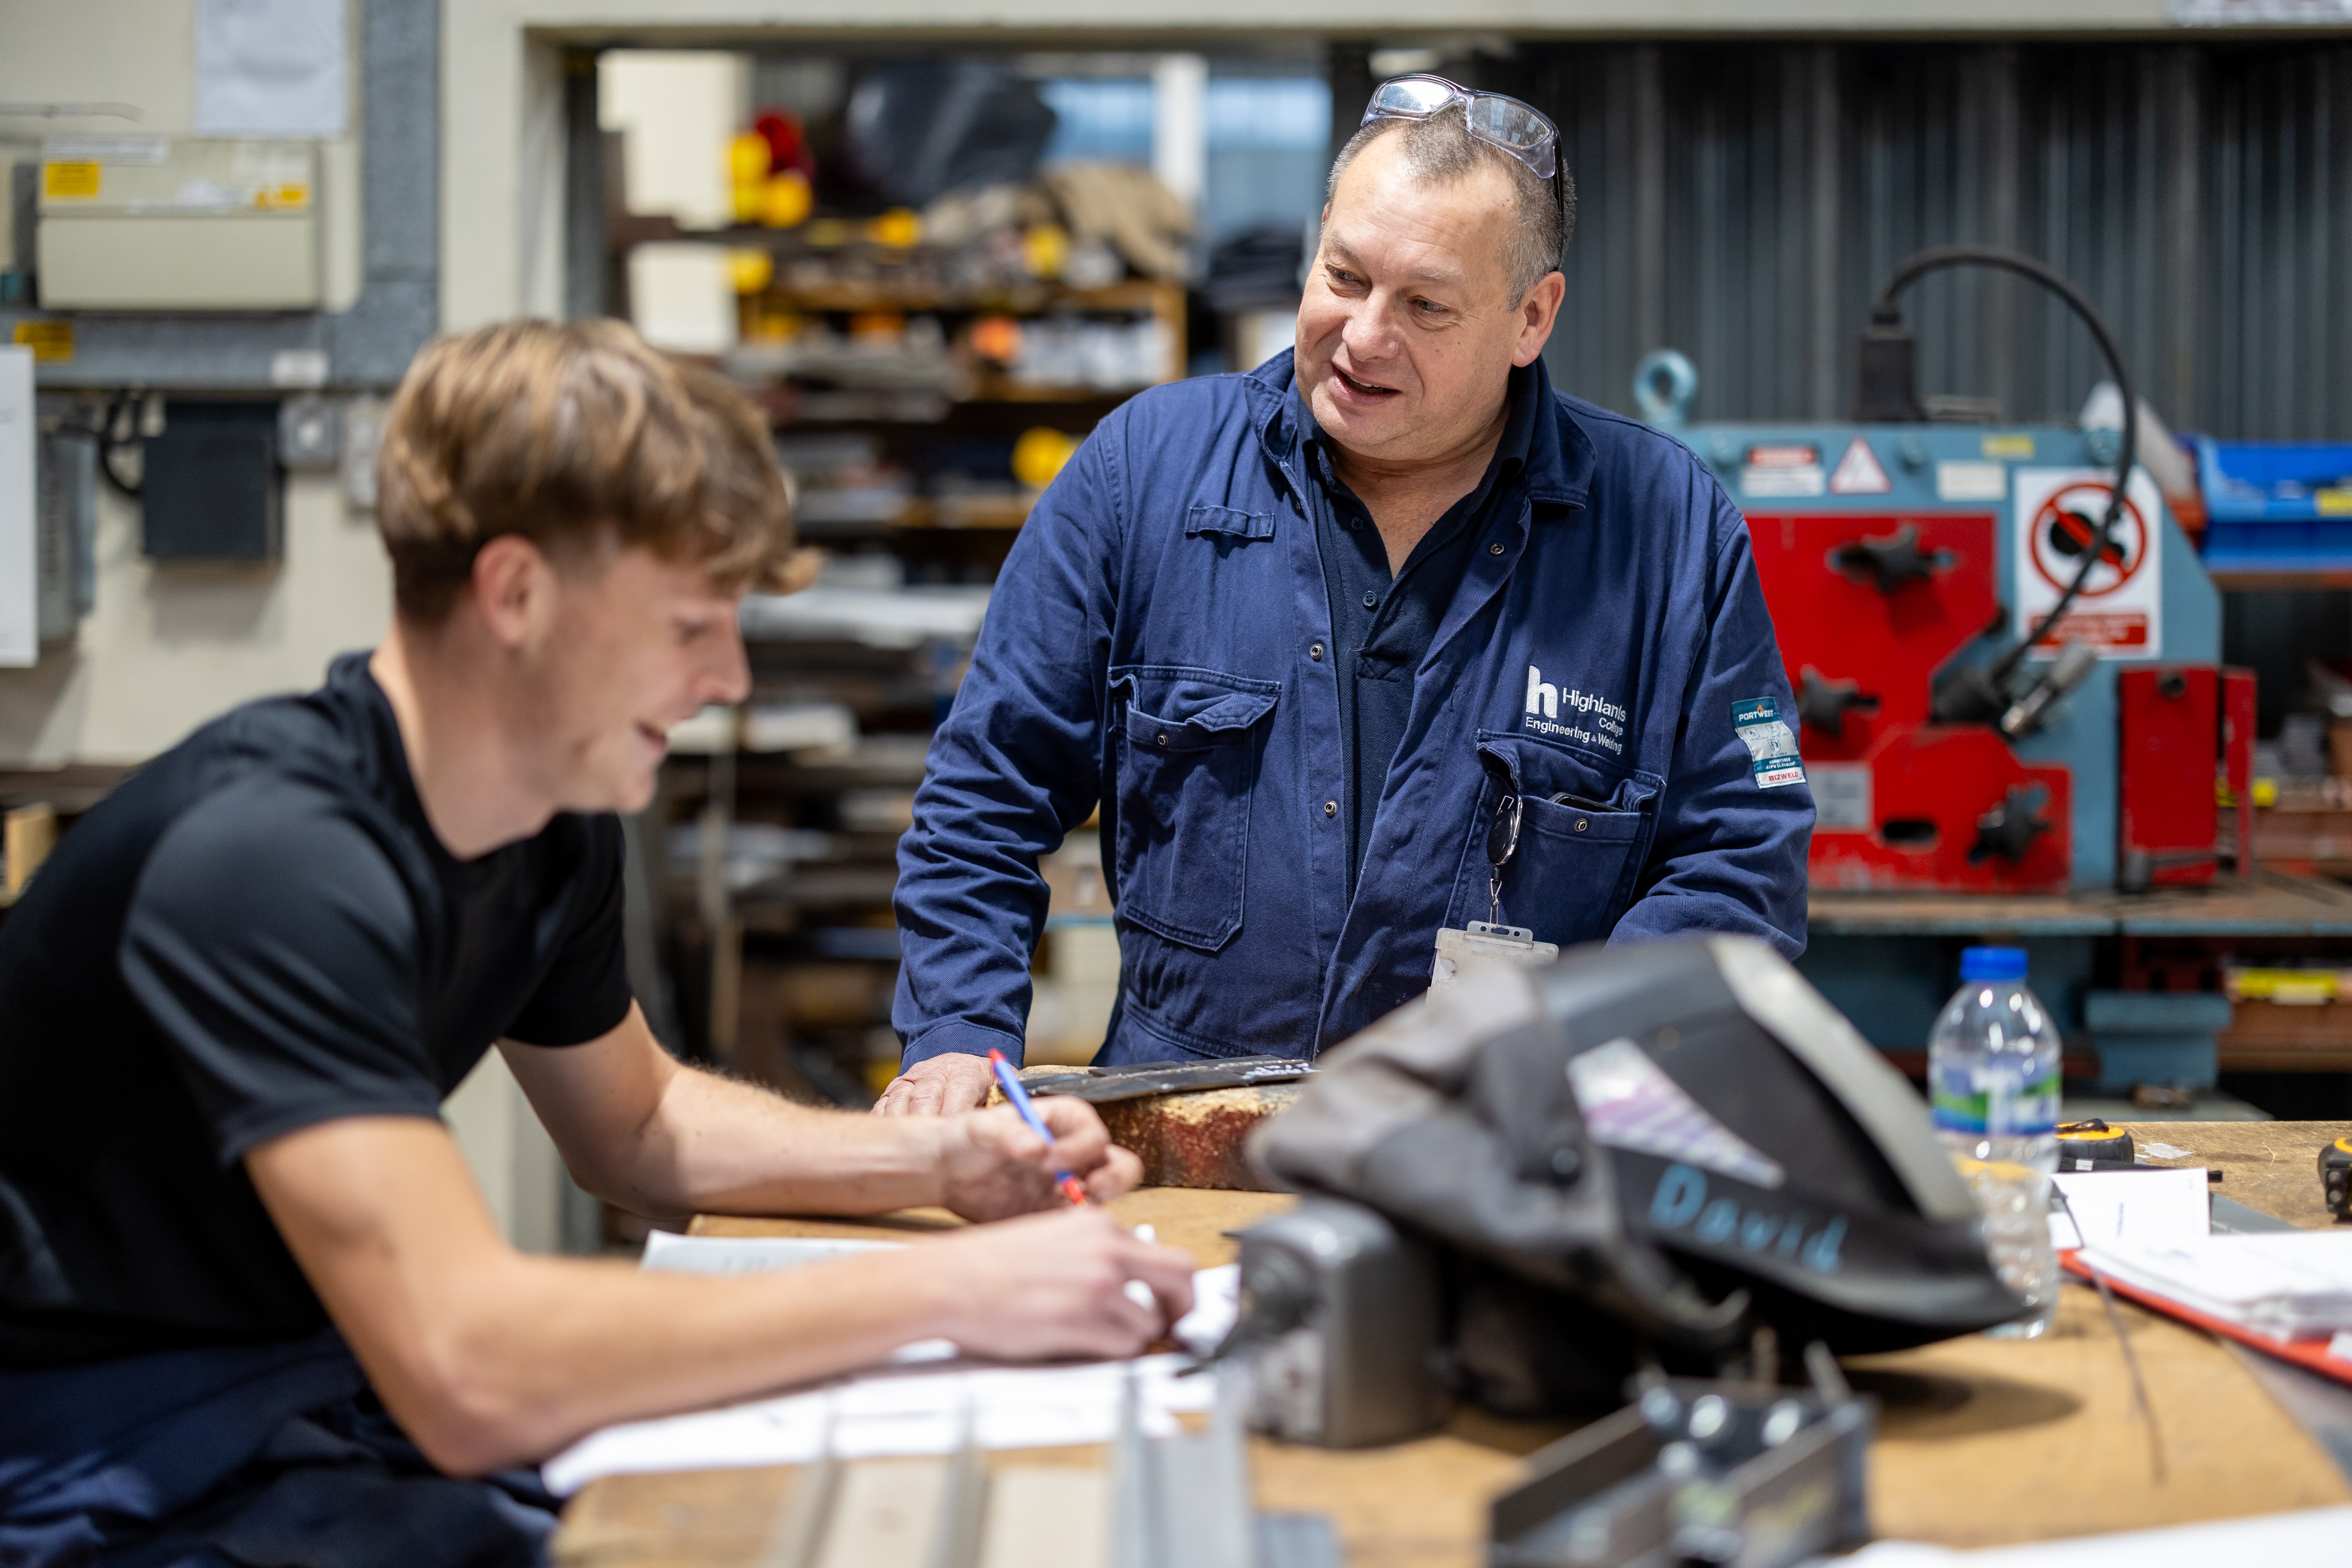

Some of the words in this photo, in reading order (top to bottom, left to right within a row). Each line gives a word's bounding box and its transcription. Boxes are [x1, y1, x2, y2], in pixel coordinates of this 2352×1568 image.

[1526, 666, 1558, 719] h
[1526, 716, 1590, 743] Engineering
[1598, 733, 1622, 755] Welding
[1739, 710, 1773, 722] PORTWEST
[1768, 772, 1798, 781] BIZWELD
[1648, 1163, 1849, 1276] David
